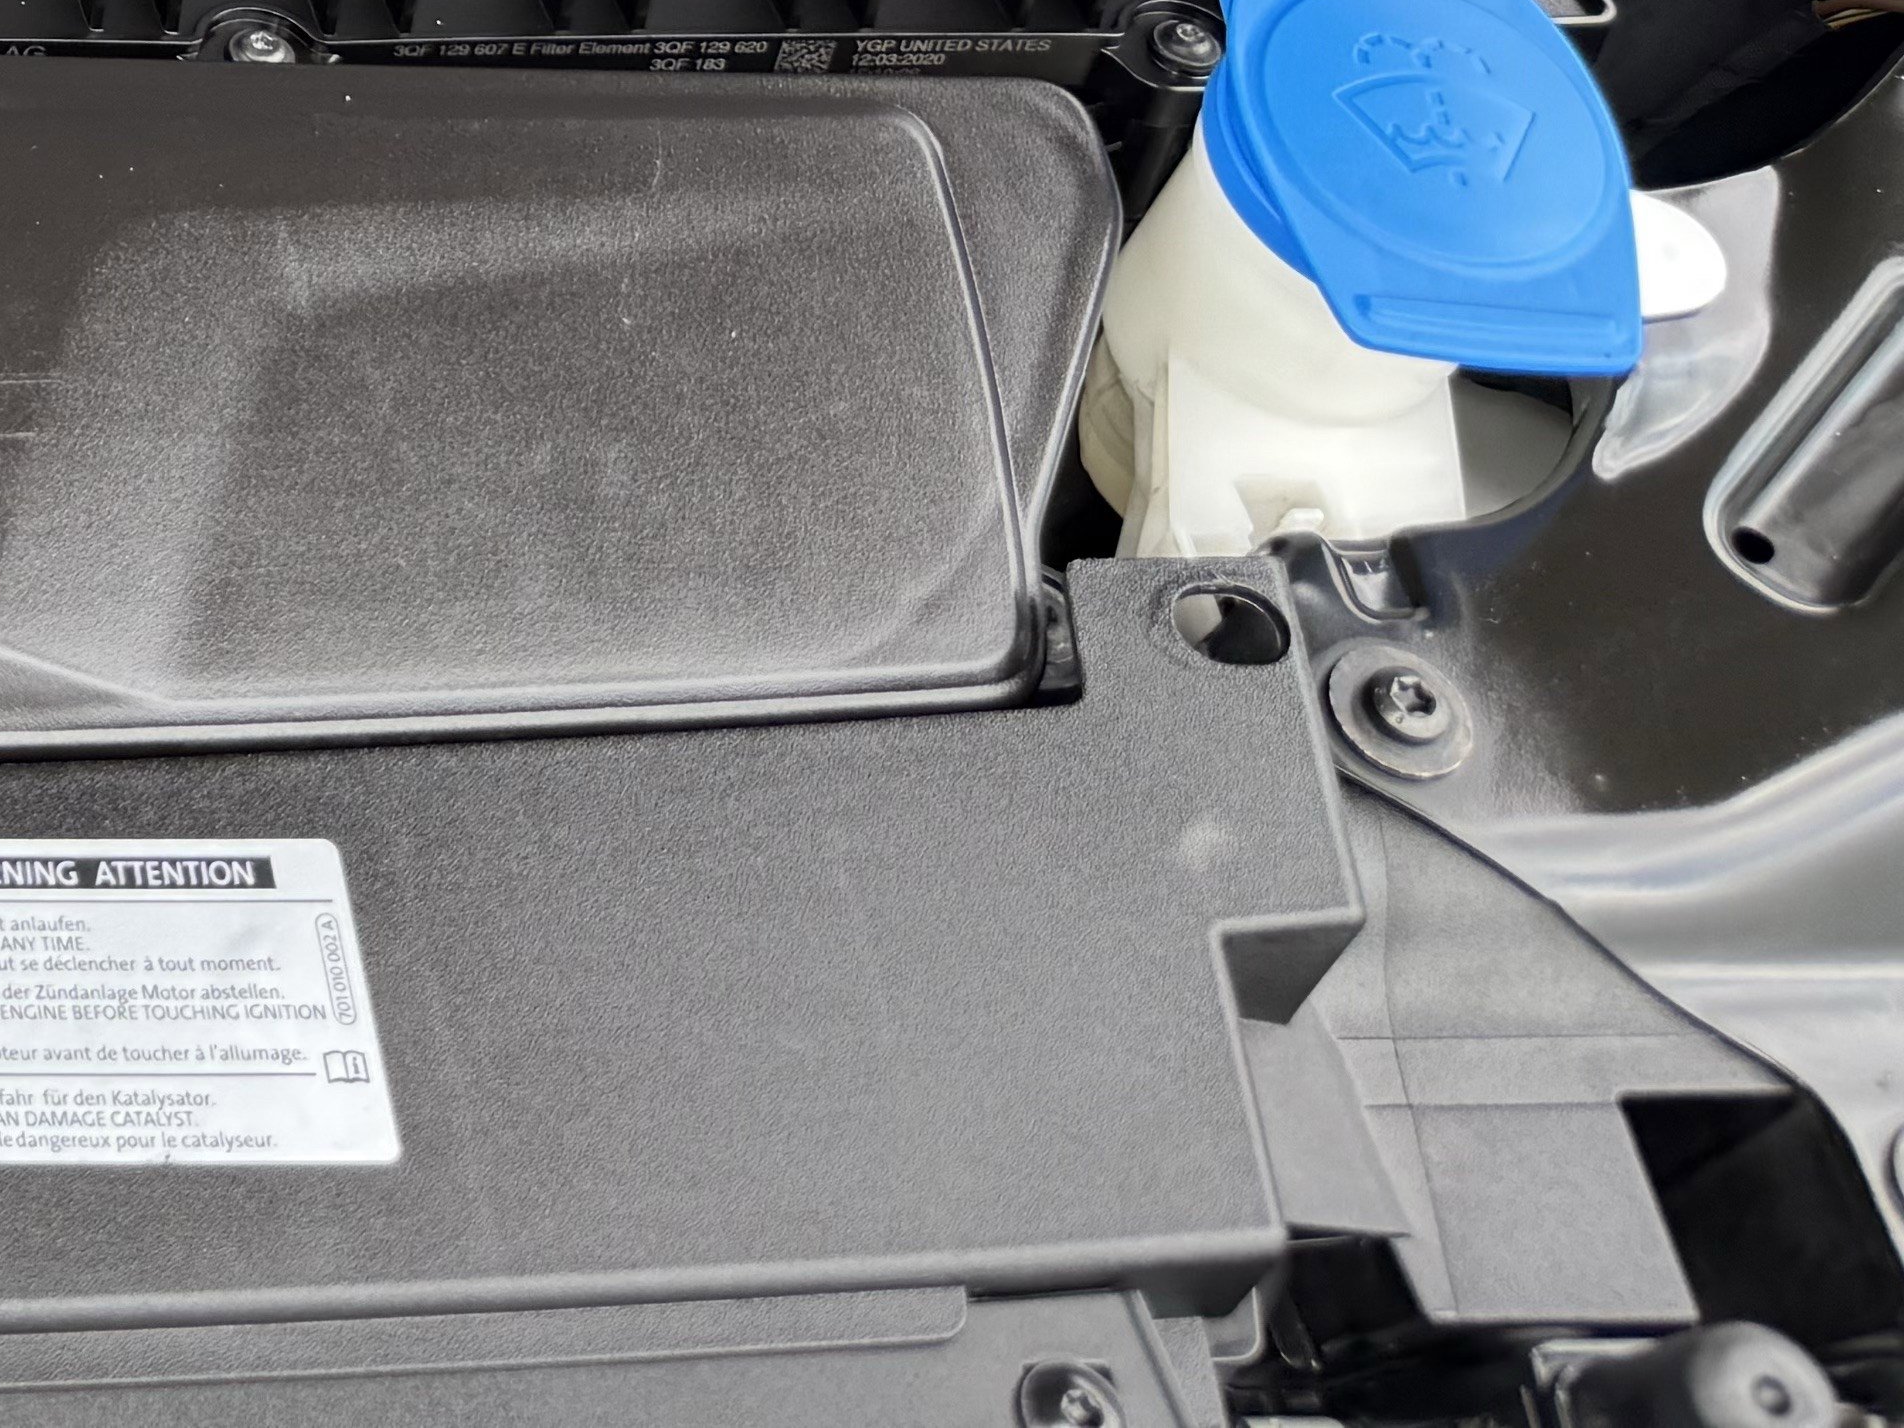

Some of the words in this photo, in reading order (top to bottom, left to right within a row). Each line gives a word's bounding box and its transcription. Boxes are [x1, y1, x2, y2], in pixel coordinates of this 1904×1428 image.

[394, 44, 436, 57] 3QF
[440, 44, 471, 56] 129
[474, 43, 505, 56] 607
[511, 43, 528, 55] E
[529, 42, 574, 55] Filter
[577, 42, 651, 55] Element
[653, 41, 696, 55] 3QF
[699, 41, 731, 54] 129
[734, 41, 767, 54] 620
[856, 38, 896, 52] YGP
[900, 38, 972, 53] UNITED
[976, 38, 1053, 53] STATES
[649, 58, 690, 71] 3QF
[694, 58, 726, 71] 183
[851, 53, 945, 67] 12:03:2020
[95, 860, 255, 886] ATTENTION
[10, 915, 92, 933] anlaufen.
[0, 936, 36, 951] ANY
[43, 956, 136, 973] déclencher
[158, 957, 197, 973] tout
[200, 958, 282, 973] moment.
[34, 984, 138, 1005] Zündanlage
[142, 985, 196, 1001] Motor
[201, 984, 285, 1001] abstellen.
[1, 1004, 68, 1021] ENGINE
[72, 1004, 139, 1021] BEFORE
[143, 1004, 241, 1021] TOUCHING
[245, 1004, 327, 1021] IGNITION
[43, 1047, 92, 1061] avant
[122, 1046, 190, 1062] toucher
[209, 1045, 309, 1066] l'allumage.
[73, 1090, 107, 1107] den
[111, 1089, 217, 1112] Katalysator.
[25, 1110, 107, 1128] DAMAGE
[110, 1110, 199, 1128] CATALYST.
[15, 1132, 110, 1153] dangereux
[116, 1134, 157, 1153] pour
[181, 1132, 278, 1153] catalyseur.
